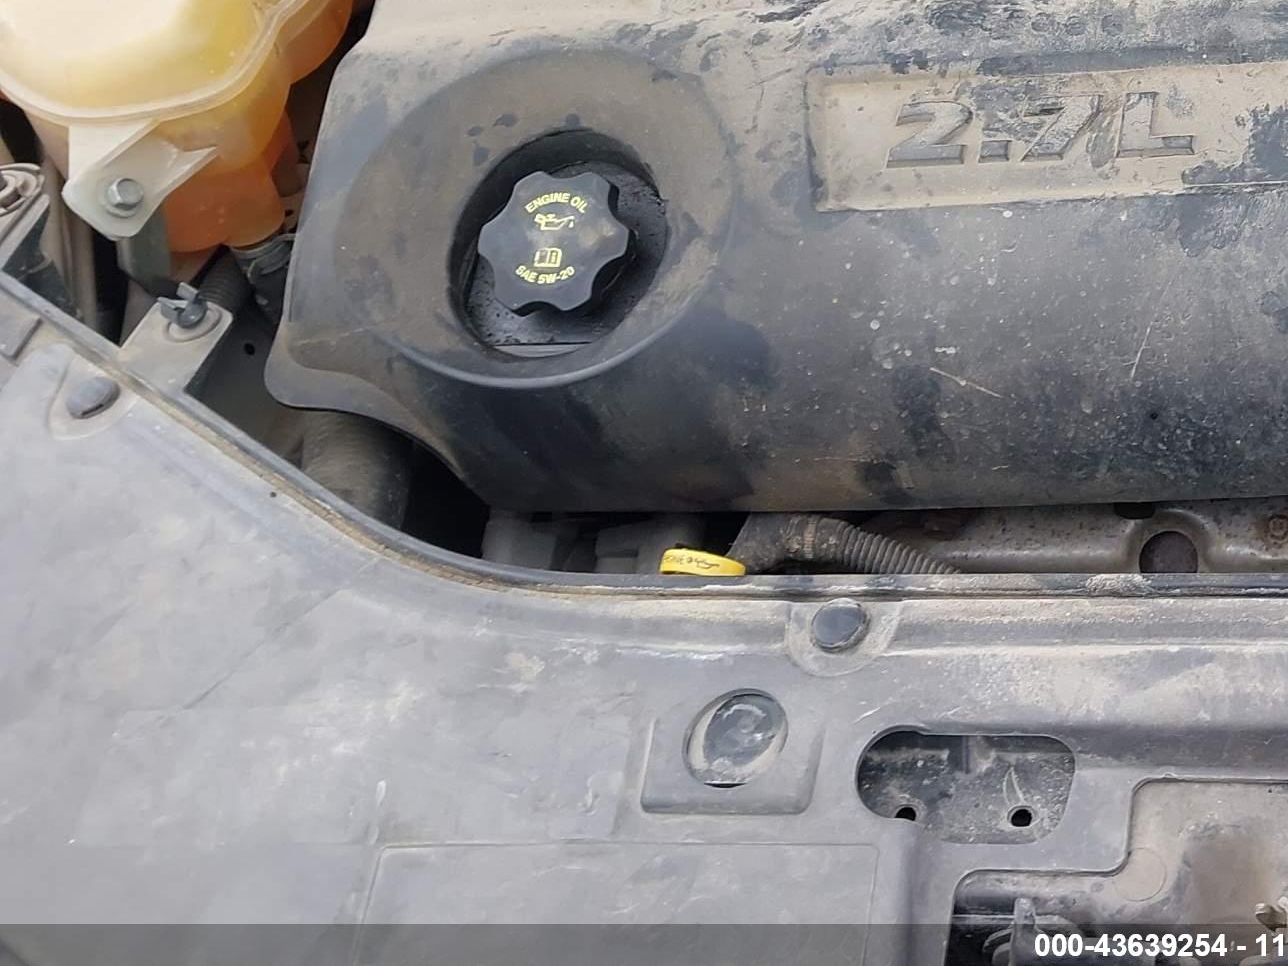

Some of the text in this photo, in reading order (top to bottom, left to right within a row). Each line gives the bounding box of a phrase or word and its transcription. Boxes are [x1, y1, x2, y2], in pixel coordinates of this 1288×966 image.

[885, 90, 1196, 169] 2.7L
[525, 192, 588, 214] ENGINE OIL
[515, 265, 575, 284] SAE 5W-20
